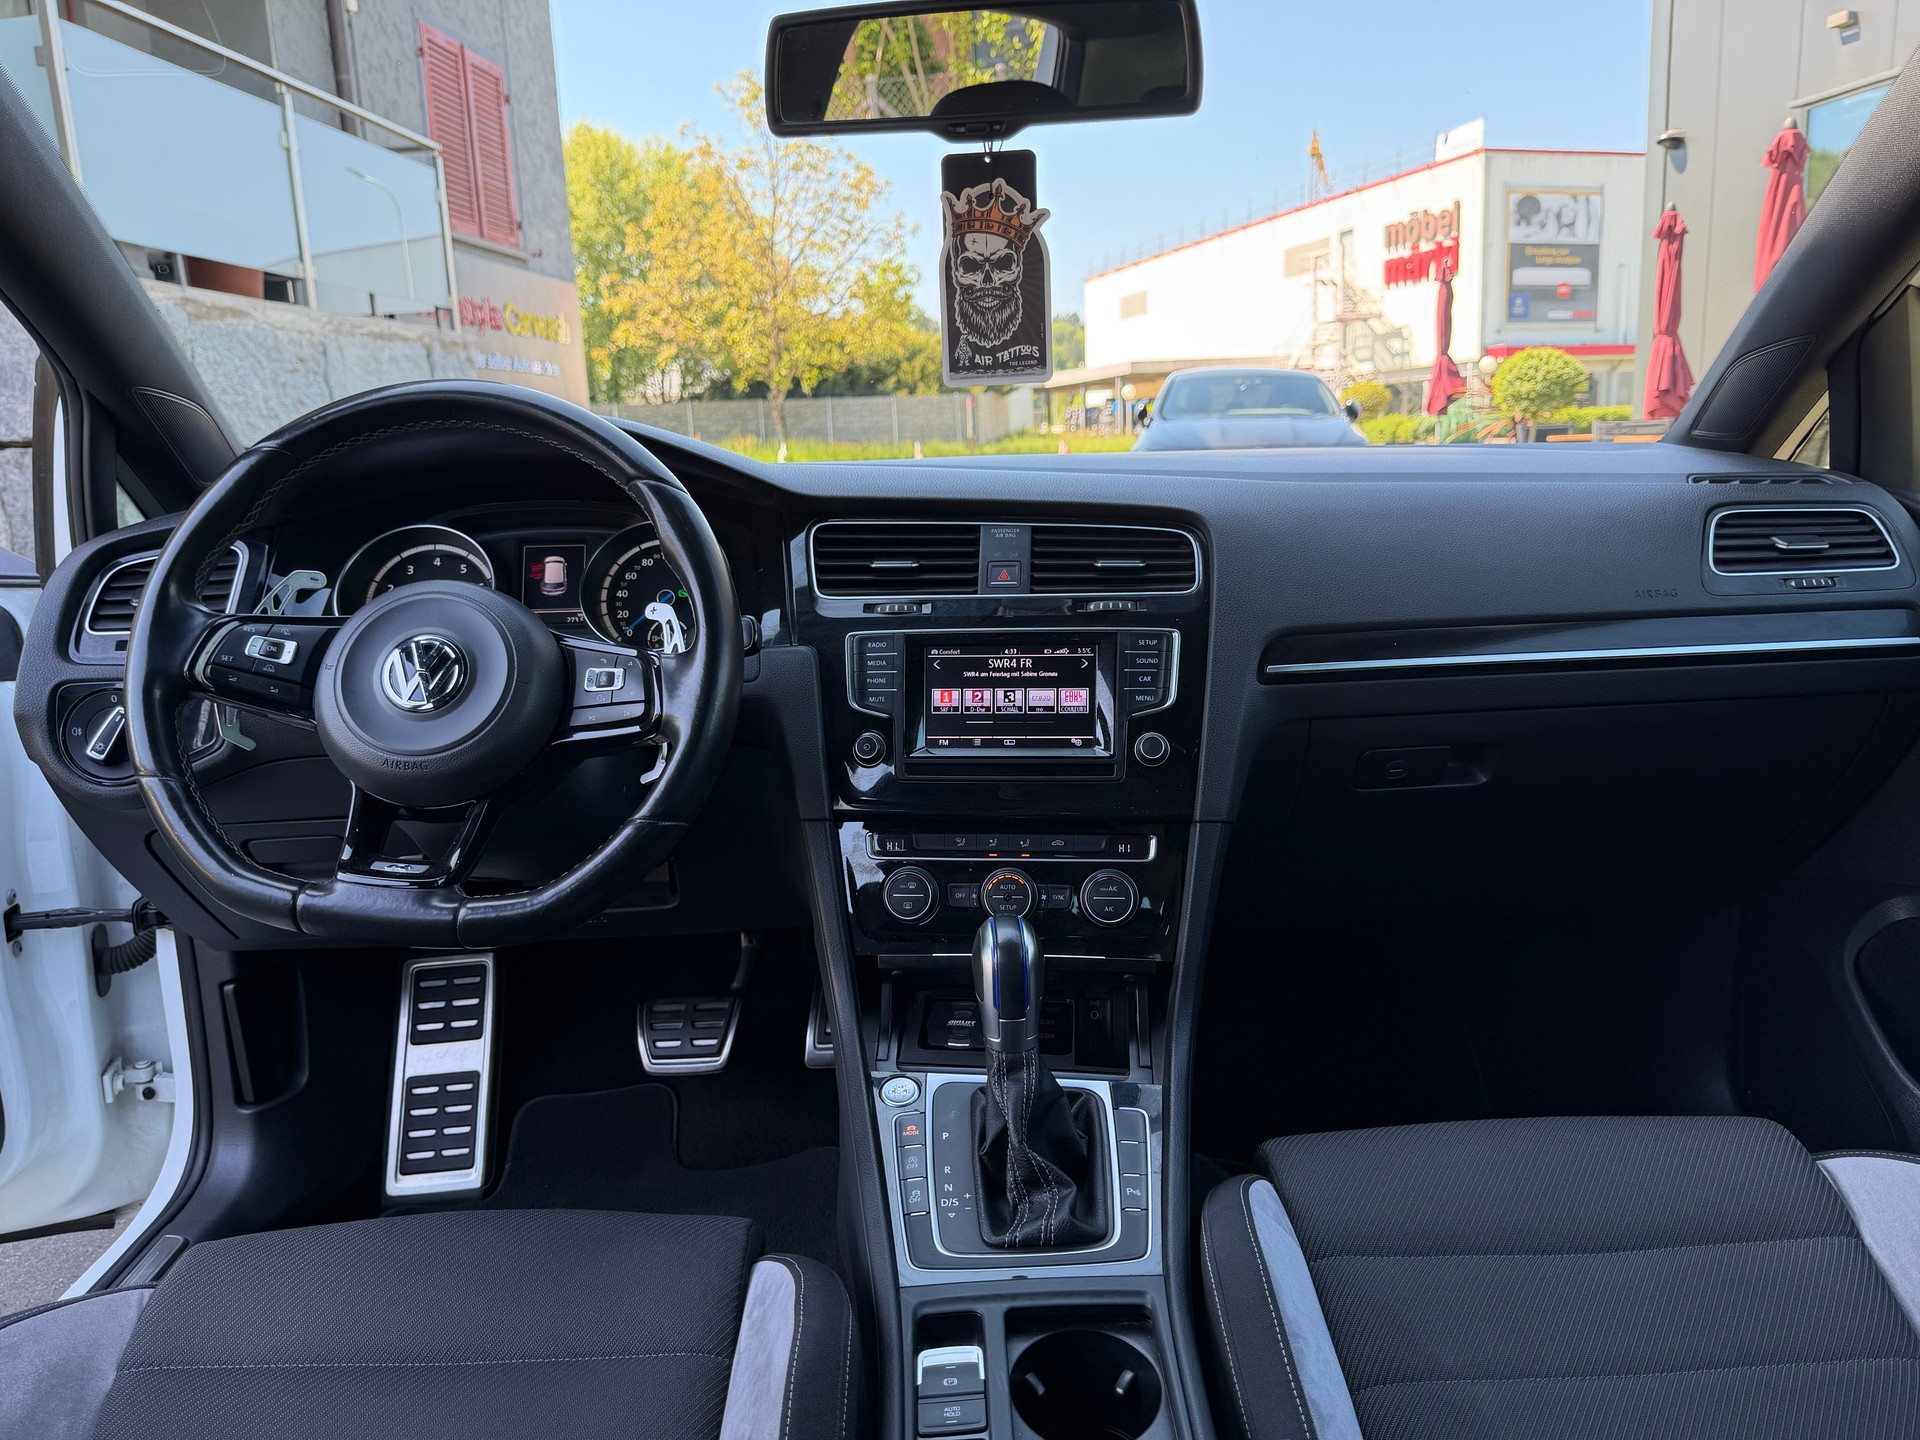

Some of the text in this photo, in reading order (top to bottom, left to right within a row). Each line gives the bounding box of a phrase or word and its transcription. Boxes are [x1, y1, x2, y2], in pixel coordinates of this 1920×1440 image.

[974, 344, 1040, 366] AIR TATTOOS
[433, 557, 442, 567] 4
[641, 559, 654, 567] 80
[407, 565, 415, 575] 3
[460, 564, 467, 574] 5
[625, 572, 637, 580] 60
[616, 590, 629, 598] 40
[1634, 588, 1678, 599] AIRBAG
[617, 610, 629, 618] 20
[626, 629, 633, 637] 0
[988, 658, 1033, 669] SWR4 FR
[989, 671, 1010, 679] Feiertag
[381, 758, 429, 771] AIRBAG
[1118, 844, 1131, 853] HI
[942, 1132, 949, 1140] P
[944, 1165, 951, 1174] R
[944, 1183, 953, 1192] N
[941, 1197, 959, 1207] D/S
